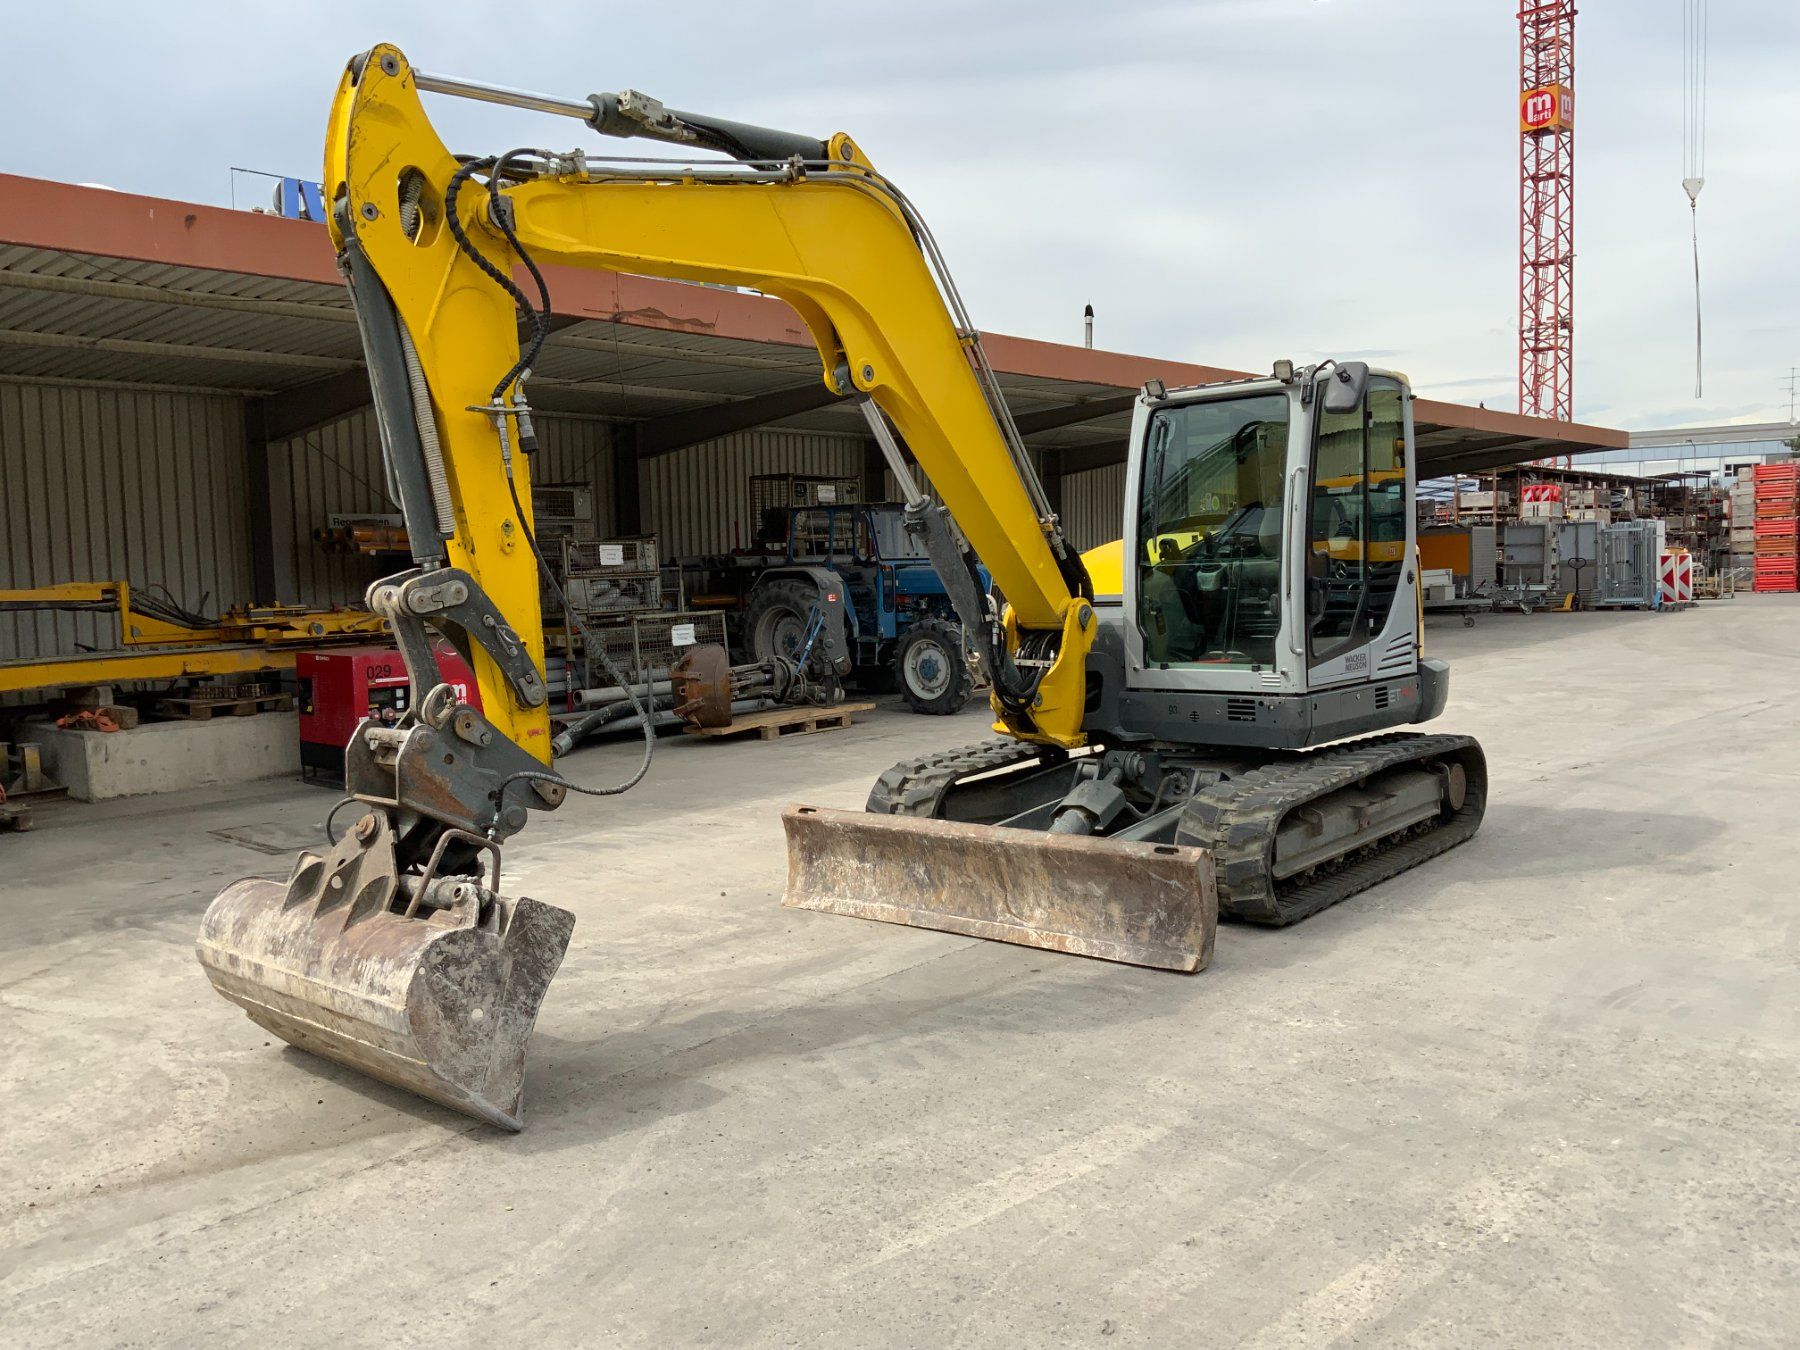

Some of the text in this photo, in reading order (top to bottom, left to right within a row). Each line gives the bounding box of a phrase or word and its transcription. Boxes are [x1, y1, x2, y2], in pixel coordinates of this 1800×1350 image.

[1344, 653, 1367, 663] WACKER
[1345, 661, 1367, 671] NEUSON
[366, 664, 392, 680] 029
